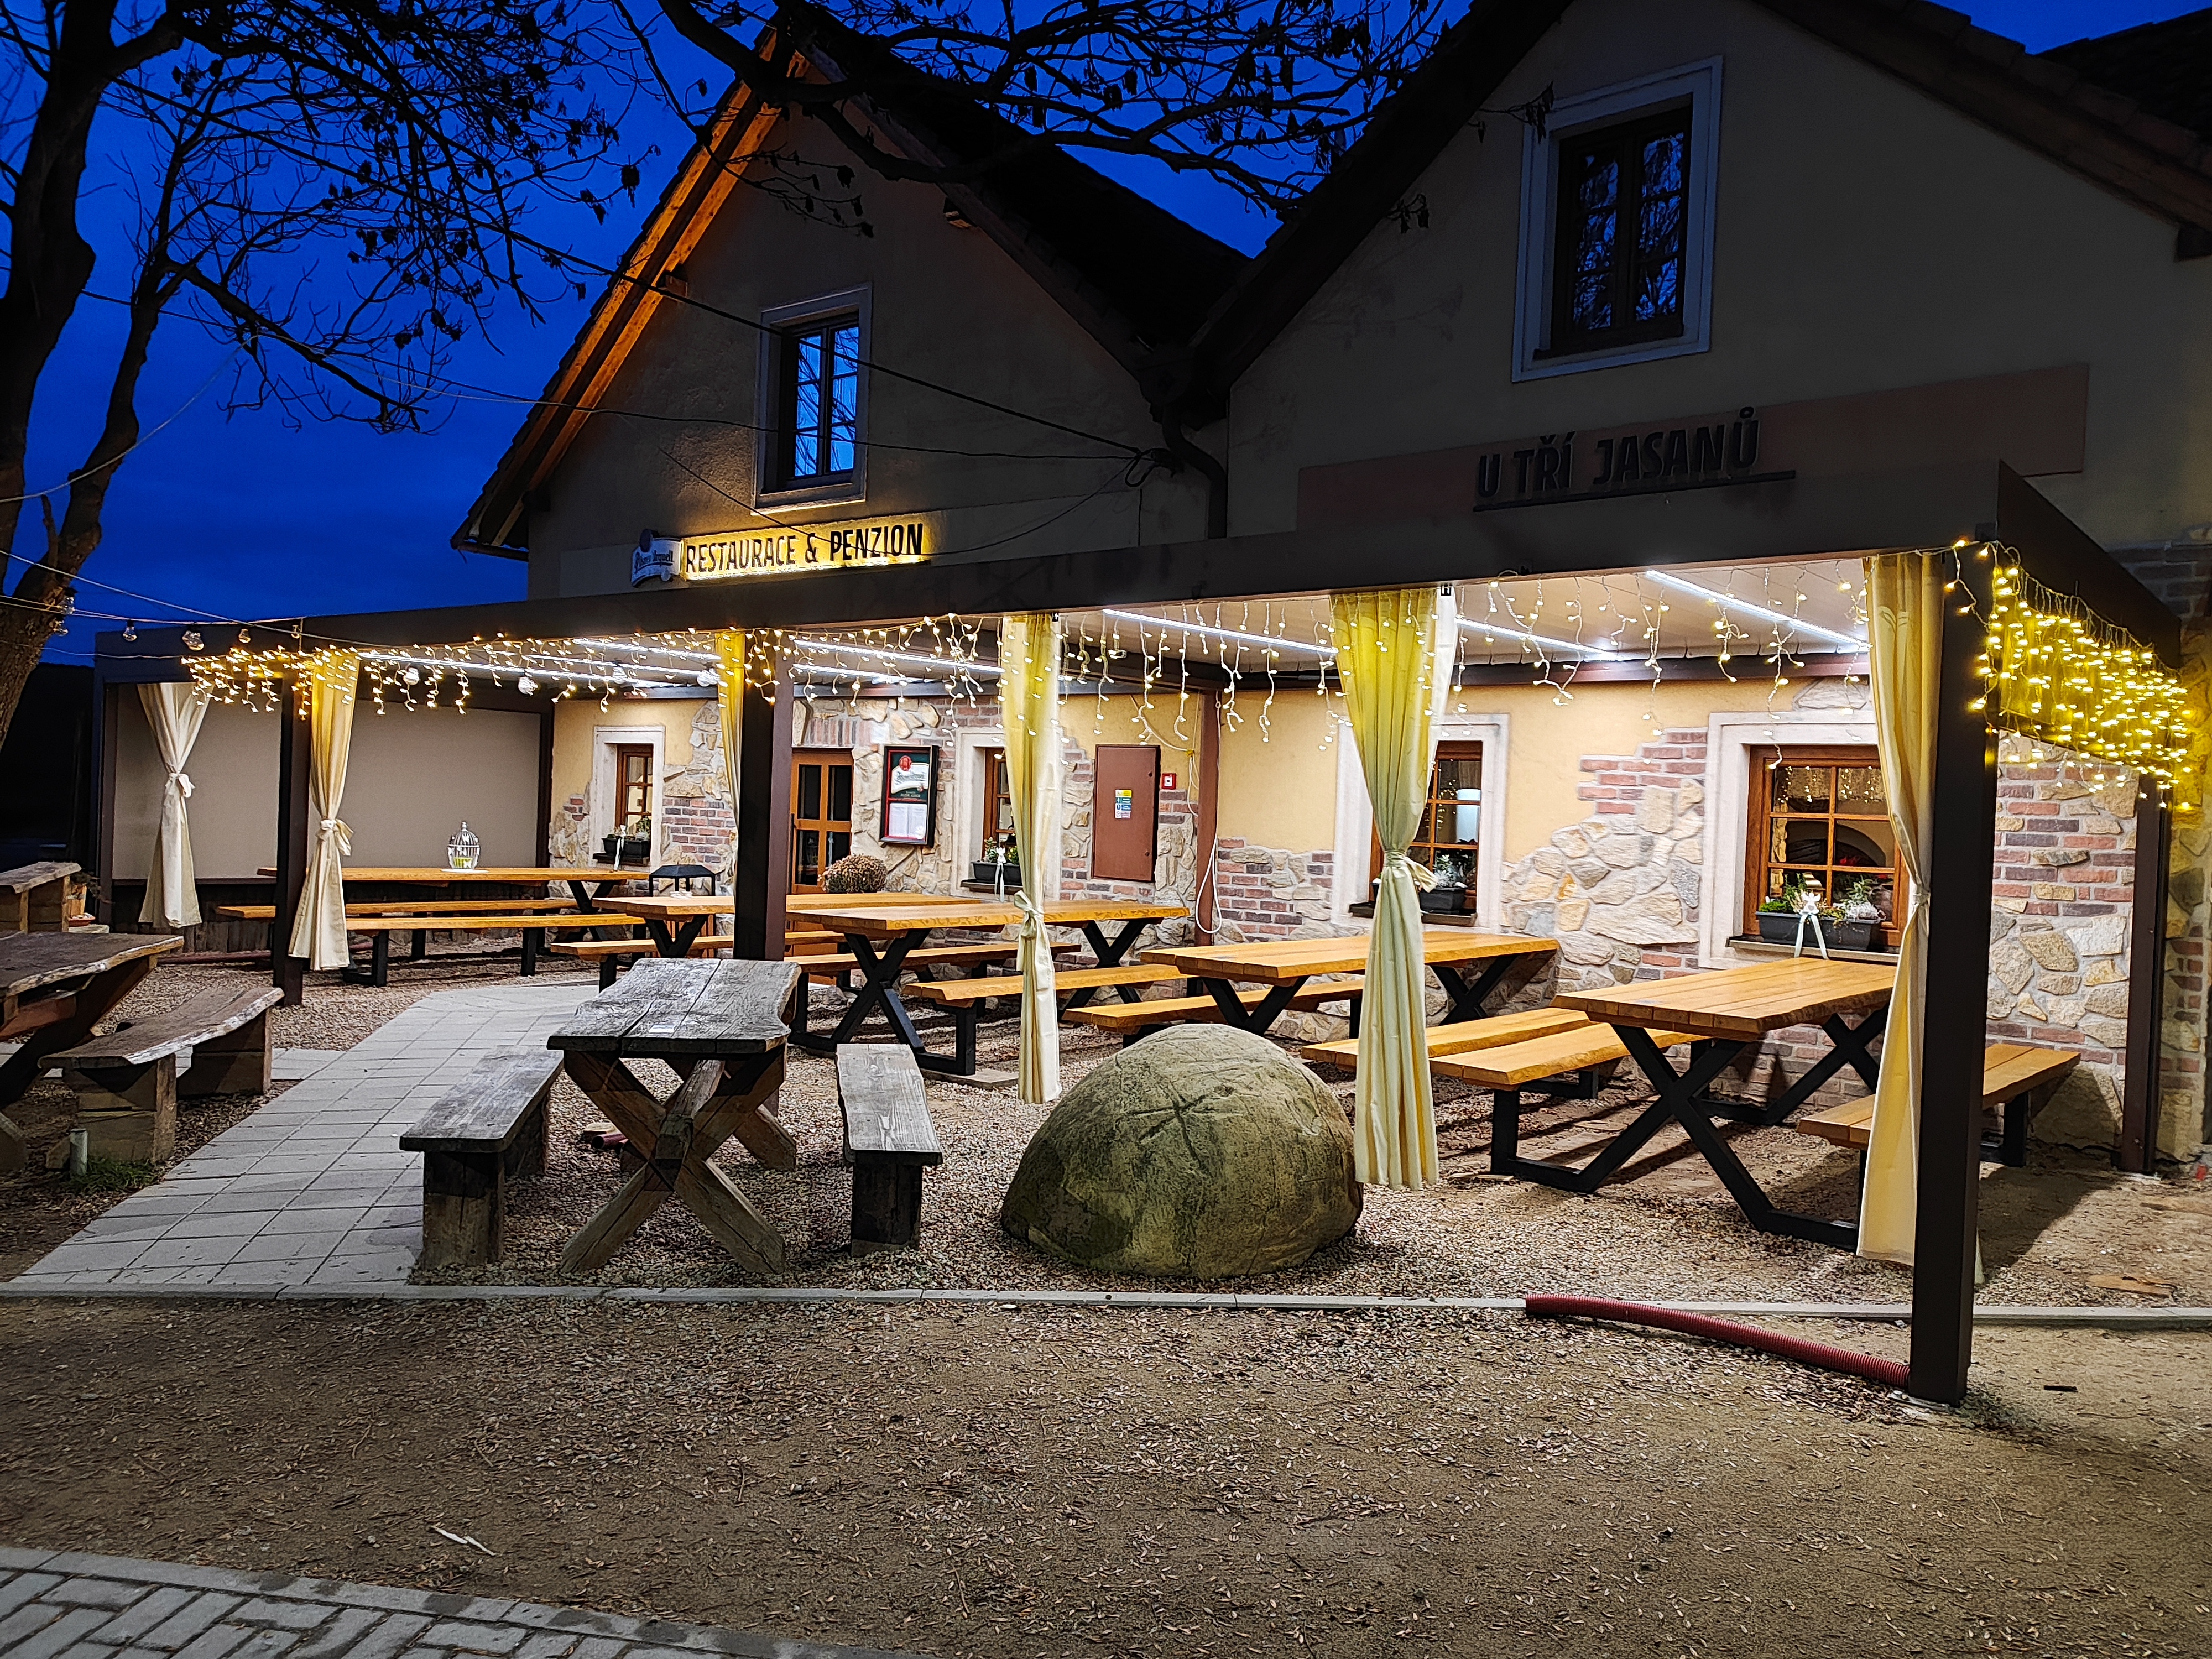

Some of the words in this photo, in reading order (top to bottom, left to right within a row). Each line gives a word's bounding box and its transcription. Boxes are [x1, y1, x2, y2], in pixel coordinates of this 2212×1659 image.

[1477, 453, 1501, 498] U
[1512, 430, 1575, 494] TŘÍ
[1592, 406, 1761, 486] JASANŮ
[686, 534, 796, 573] RESTAURACE
[805, 533, 818, 563] &
[830, 523, 924, 561] PENZION
